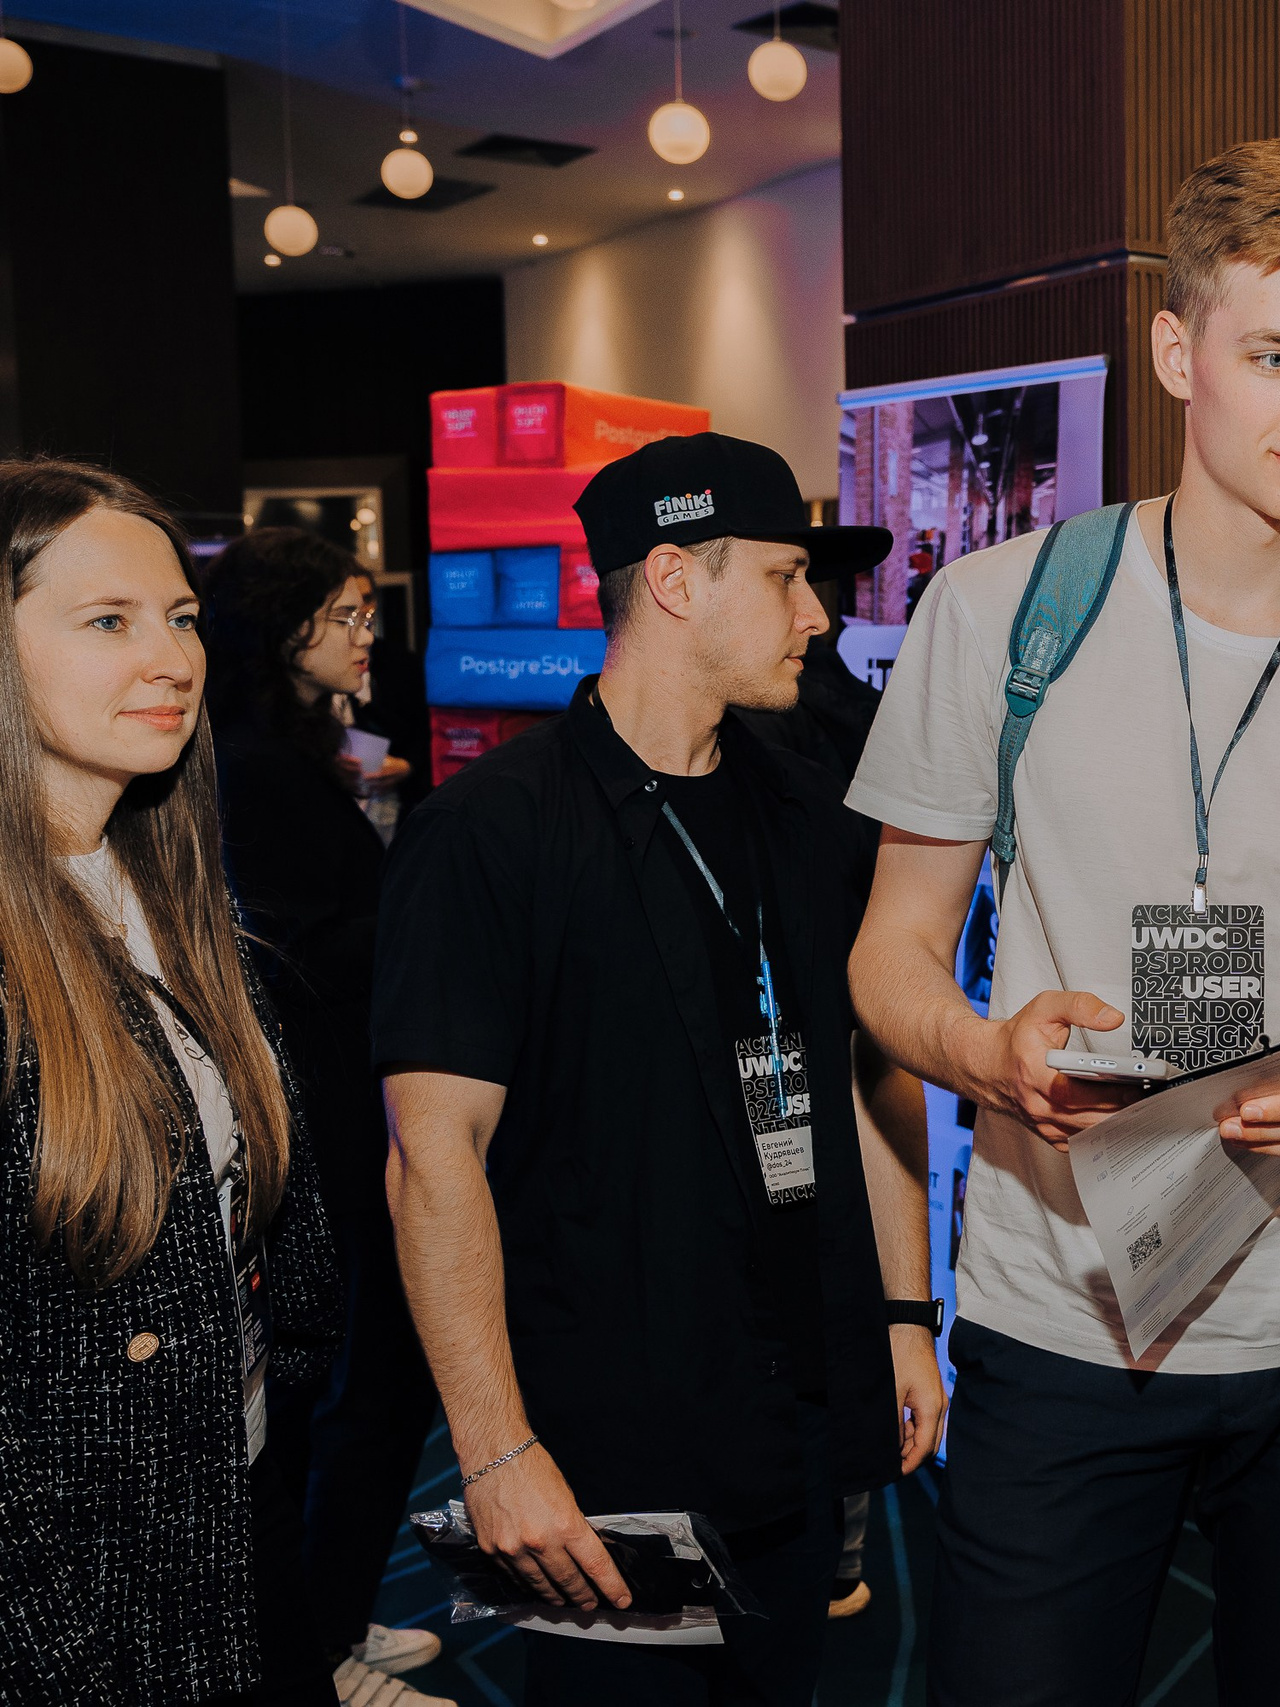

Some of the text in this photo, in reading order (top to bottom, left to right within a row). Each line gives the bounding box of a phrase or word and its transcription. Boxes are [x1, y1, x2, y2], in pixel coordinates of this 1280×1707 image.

[663, 508, 710, 523] GAMES
[460, 655, 585, 680] PostgreSQL
[762, 1138, 793, 1151] Евгений
[764, 1146, 805, 1161] Кудрявцев
